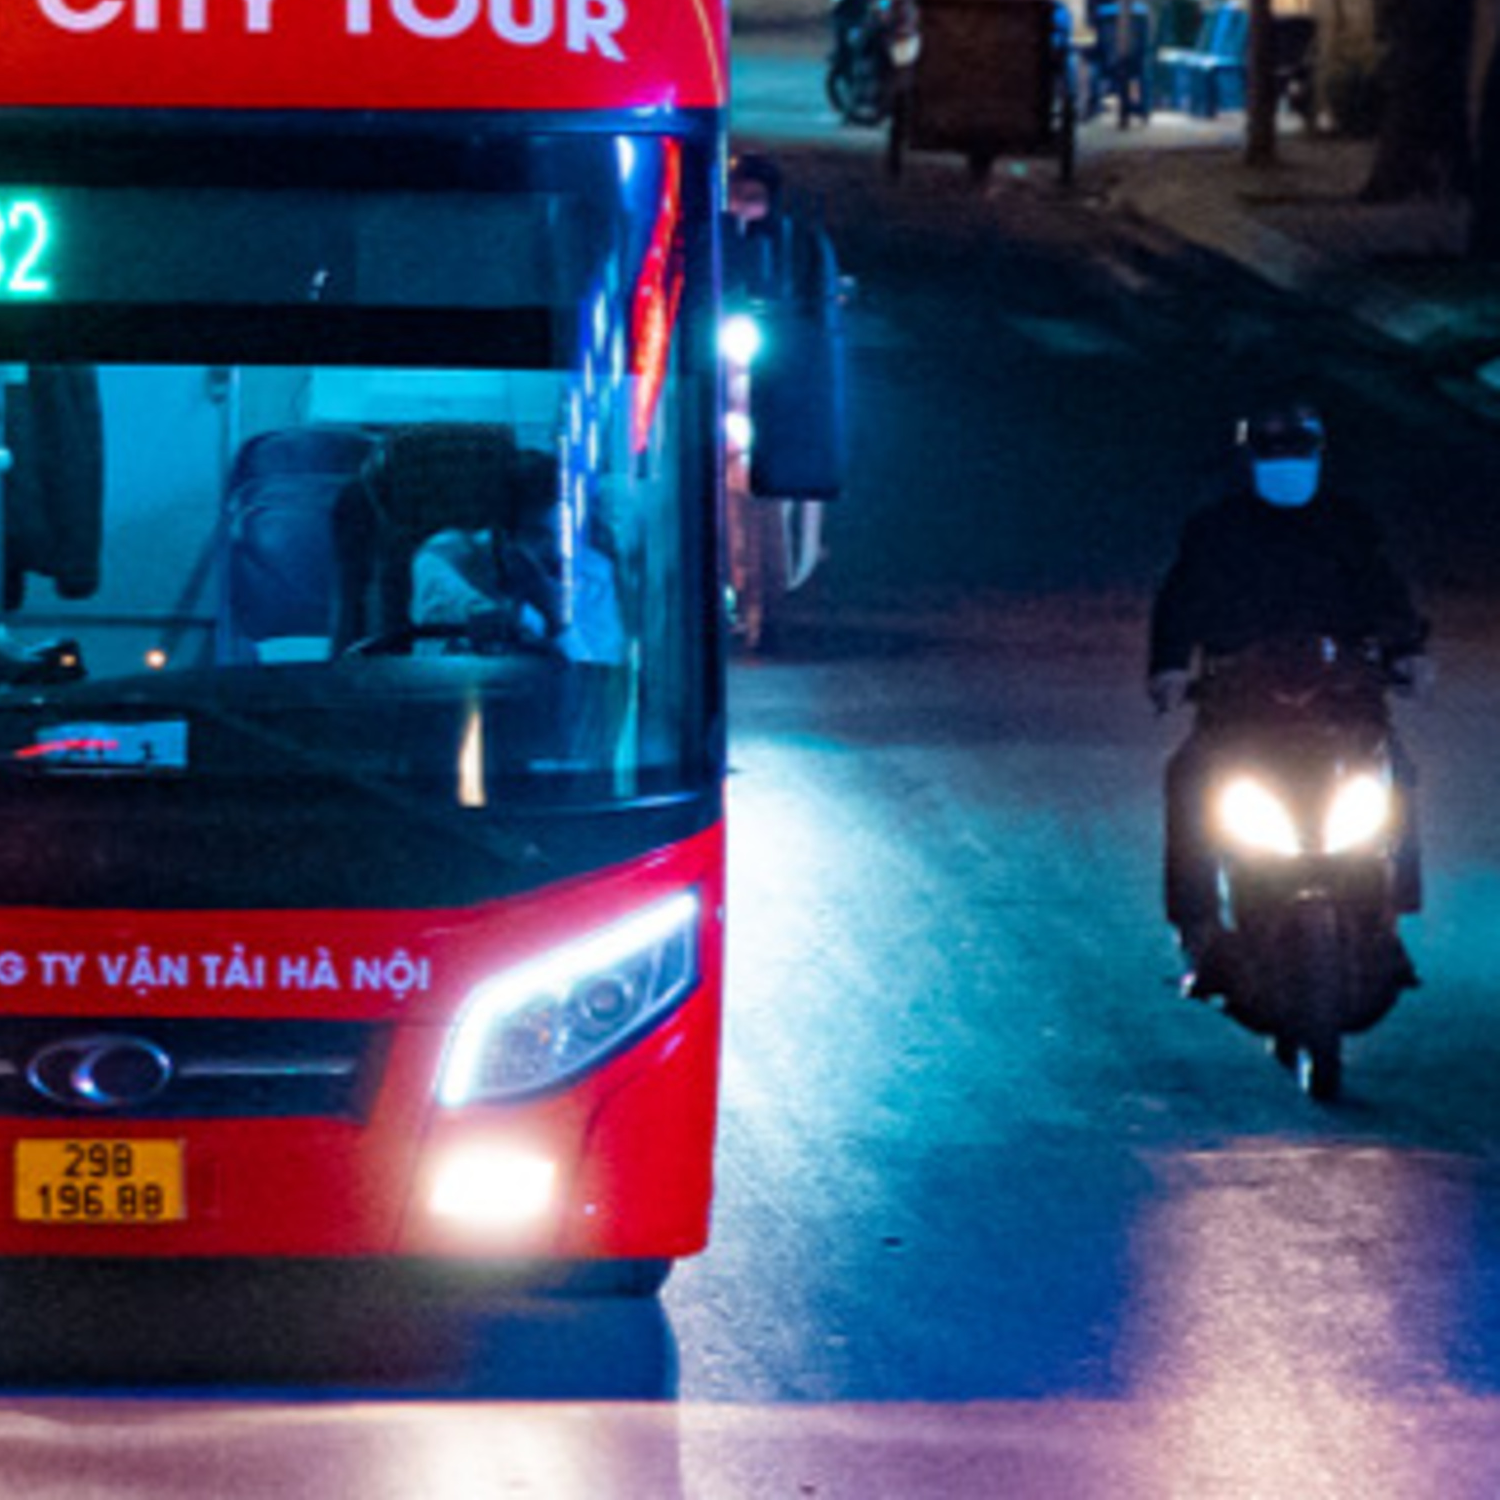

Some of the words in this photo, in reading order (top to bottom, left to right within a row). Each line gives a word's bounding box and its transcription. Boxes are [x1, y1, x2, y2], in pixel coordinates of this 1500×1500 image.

[37, 952, 85, 986] TY
[98, 944, 190, 997] VẬN
[199, 941, 267, 988] TẢI
[278, 945, 340, 990] HÀ
[353, 946, 431, 1001] NỘI
[63, 1141, 134, 1178] 29B
